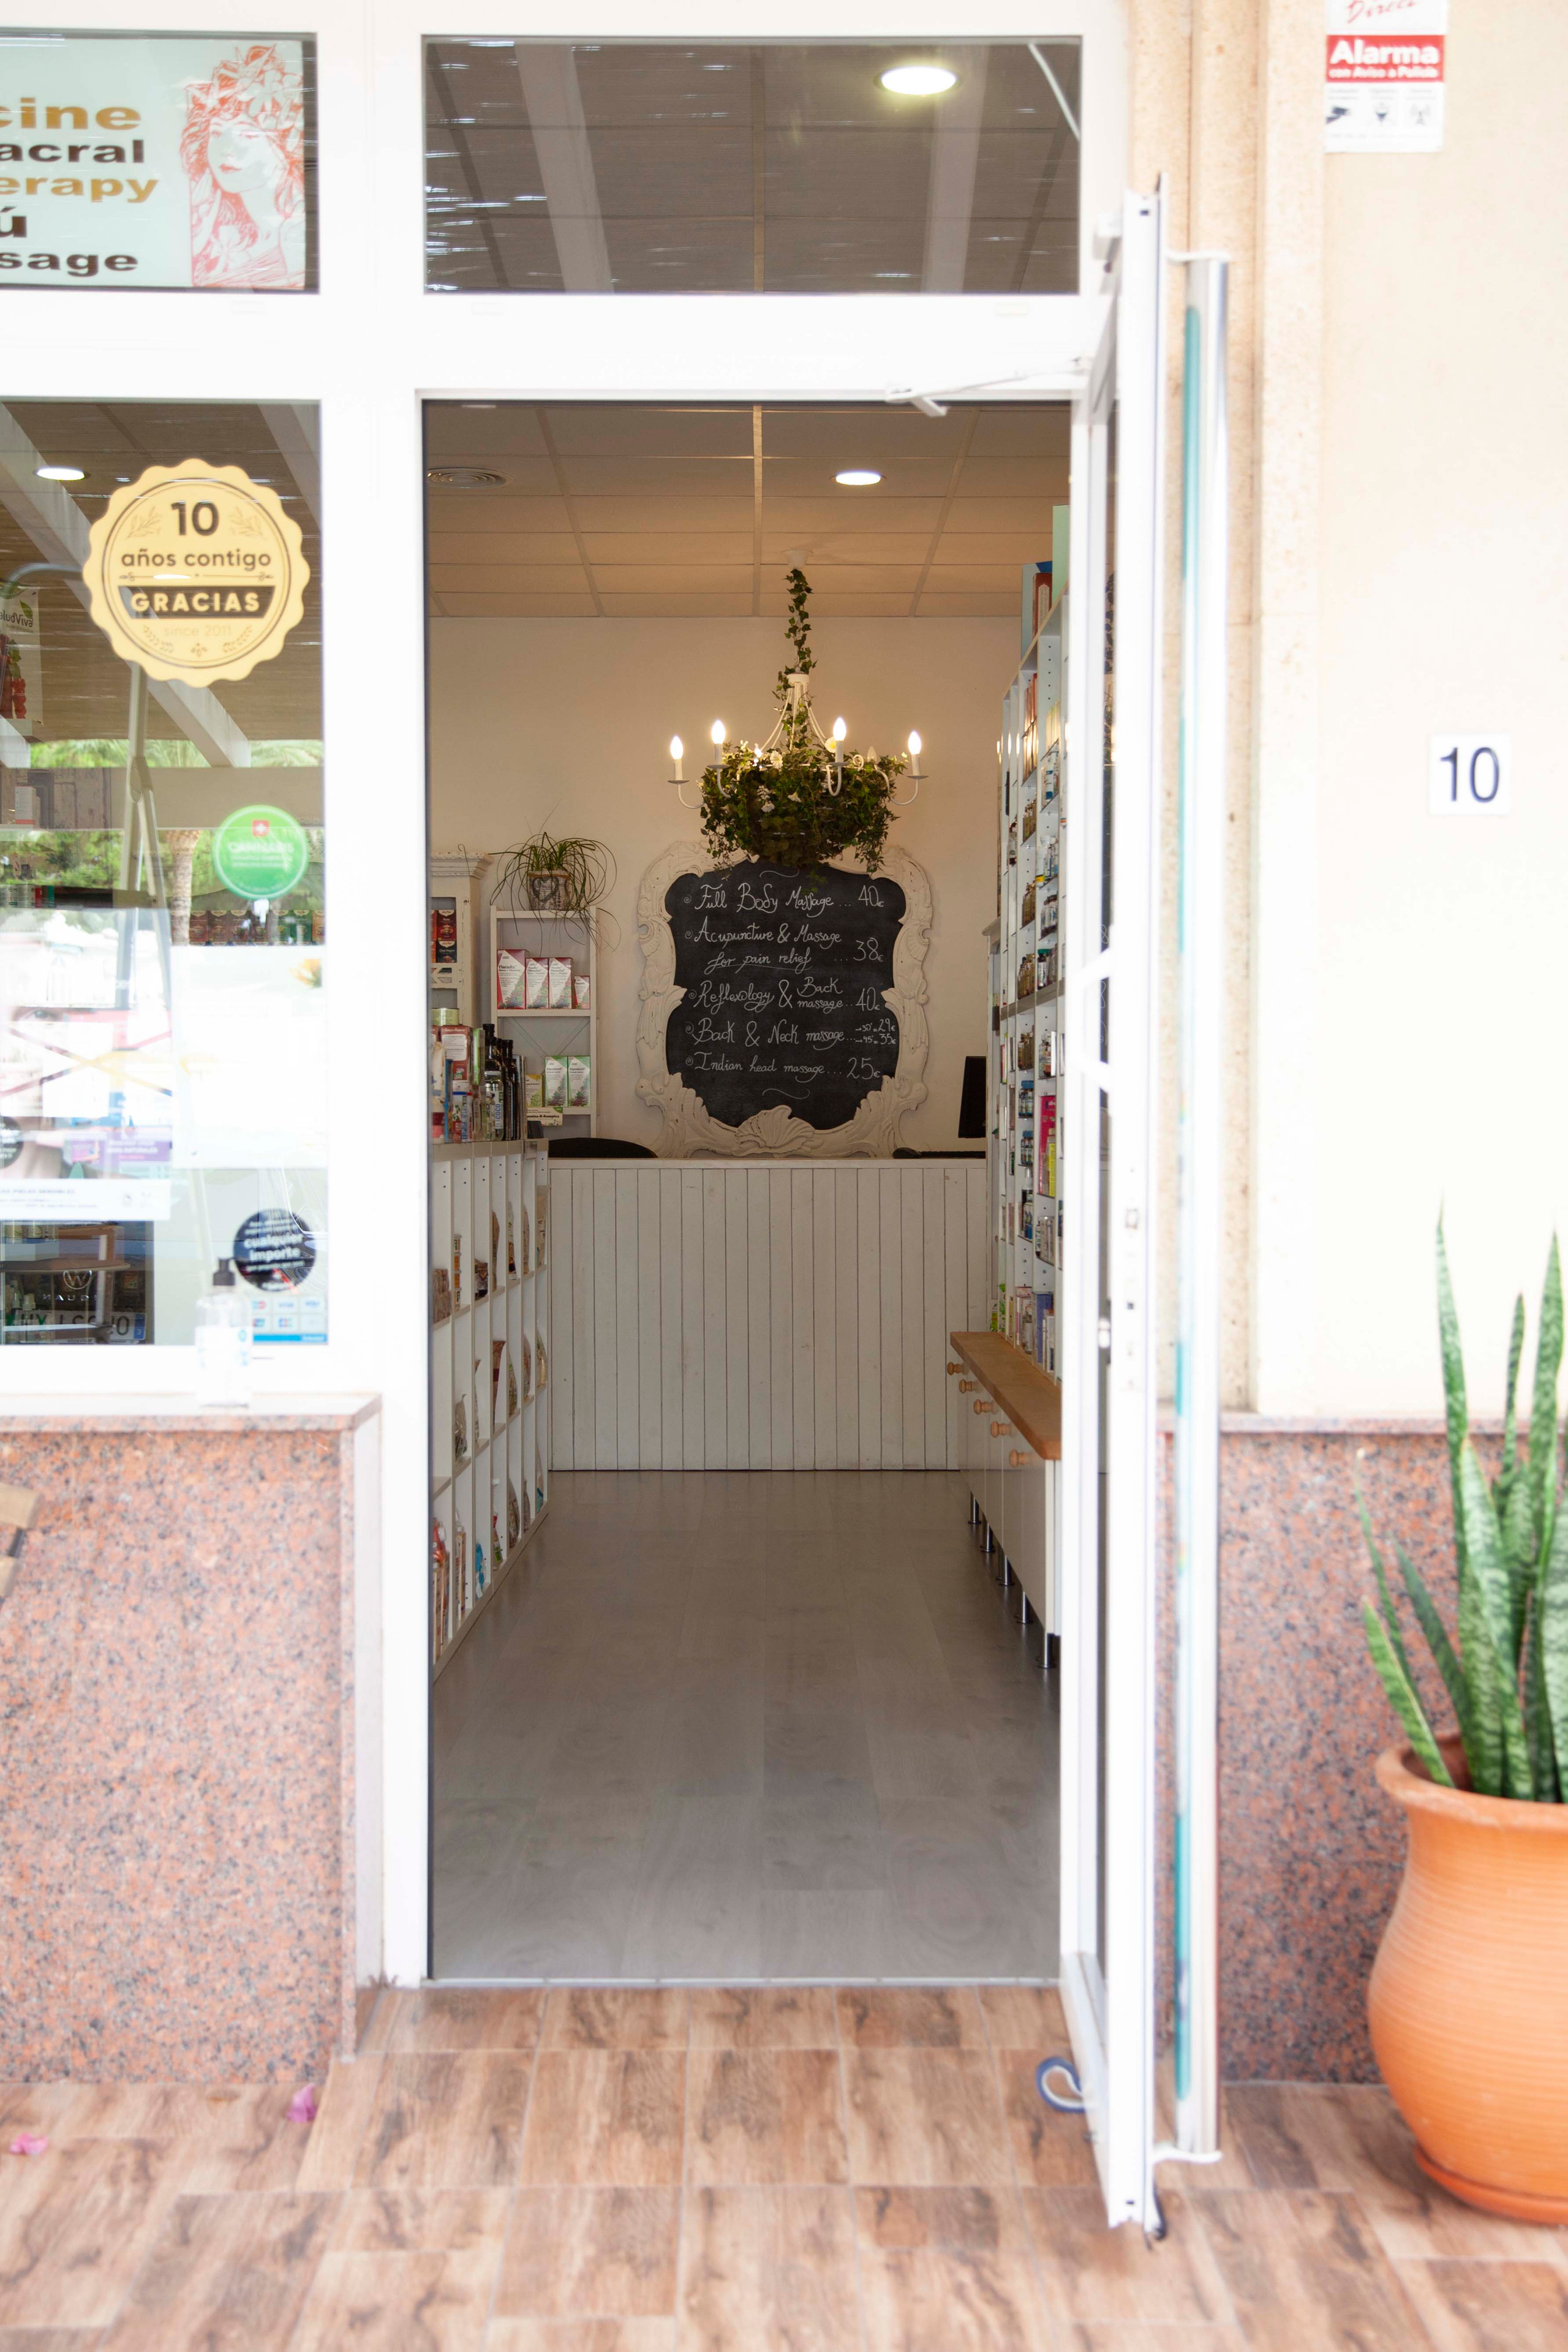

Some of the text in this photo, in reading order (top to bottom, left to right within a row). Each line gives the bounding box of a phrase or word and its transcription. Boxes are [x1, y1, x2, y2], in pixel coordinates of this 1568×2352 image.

[1329, 39, 1439, 64] Alarma
[171, 499, 219, 537] 10
[121, 548, 271, 571] años contigo
[130, 592, 260, 612] GRACIAS
[164, 625, 232, 637] since 2011
[1440, 747, 1499, 804] 10
[695, 884, 727, 910] Full
[736, 883, 778, 913] Body
[694, 916, 842, 950] Acupuncture & Massage
[704, 953, 735, 974] for
[736, 953, 771, 974] pain
[779, 948, 812, 974] relief
[693, 977, 843, 1014] Reflexology & Back
[797, 1000, 843, 1014] massage
[692, 1017, 734, 1045] Back
[745, 1021, 760, 1047] &
[767, 1019, 799, 1044] Neck
[695, 1052, 743, 1071] Indian
[750, 1055, 777, 1072] head
